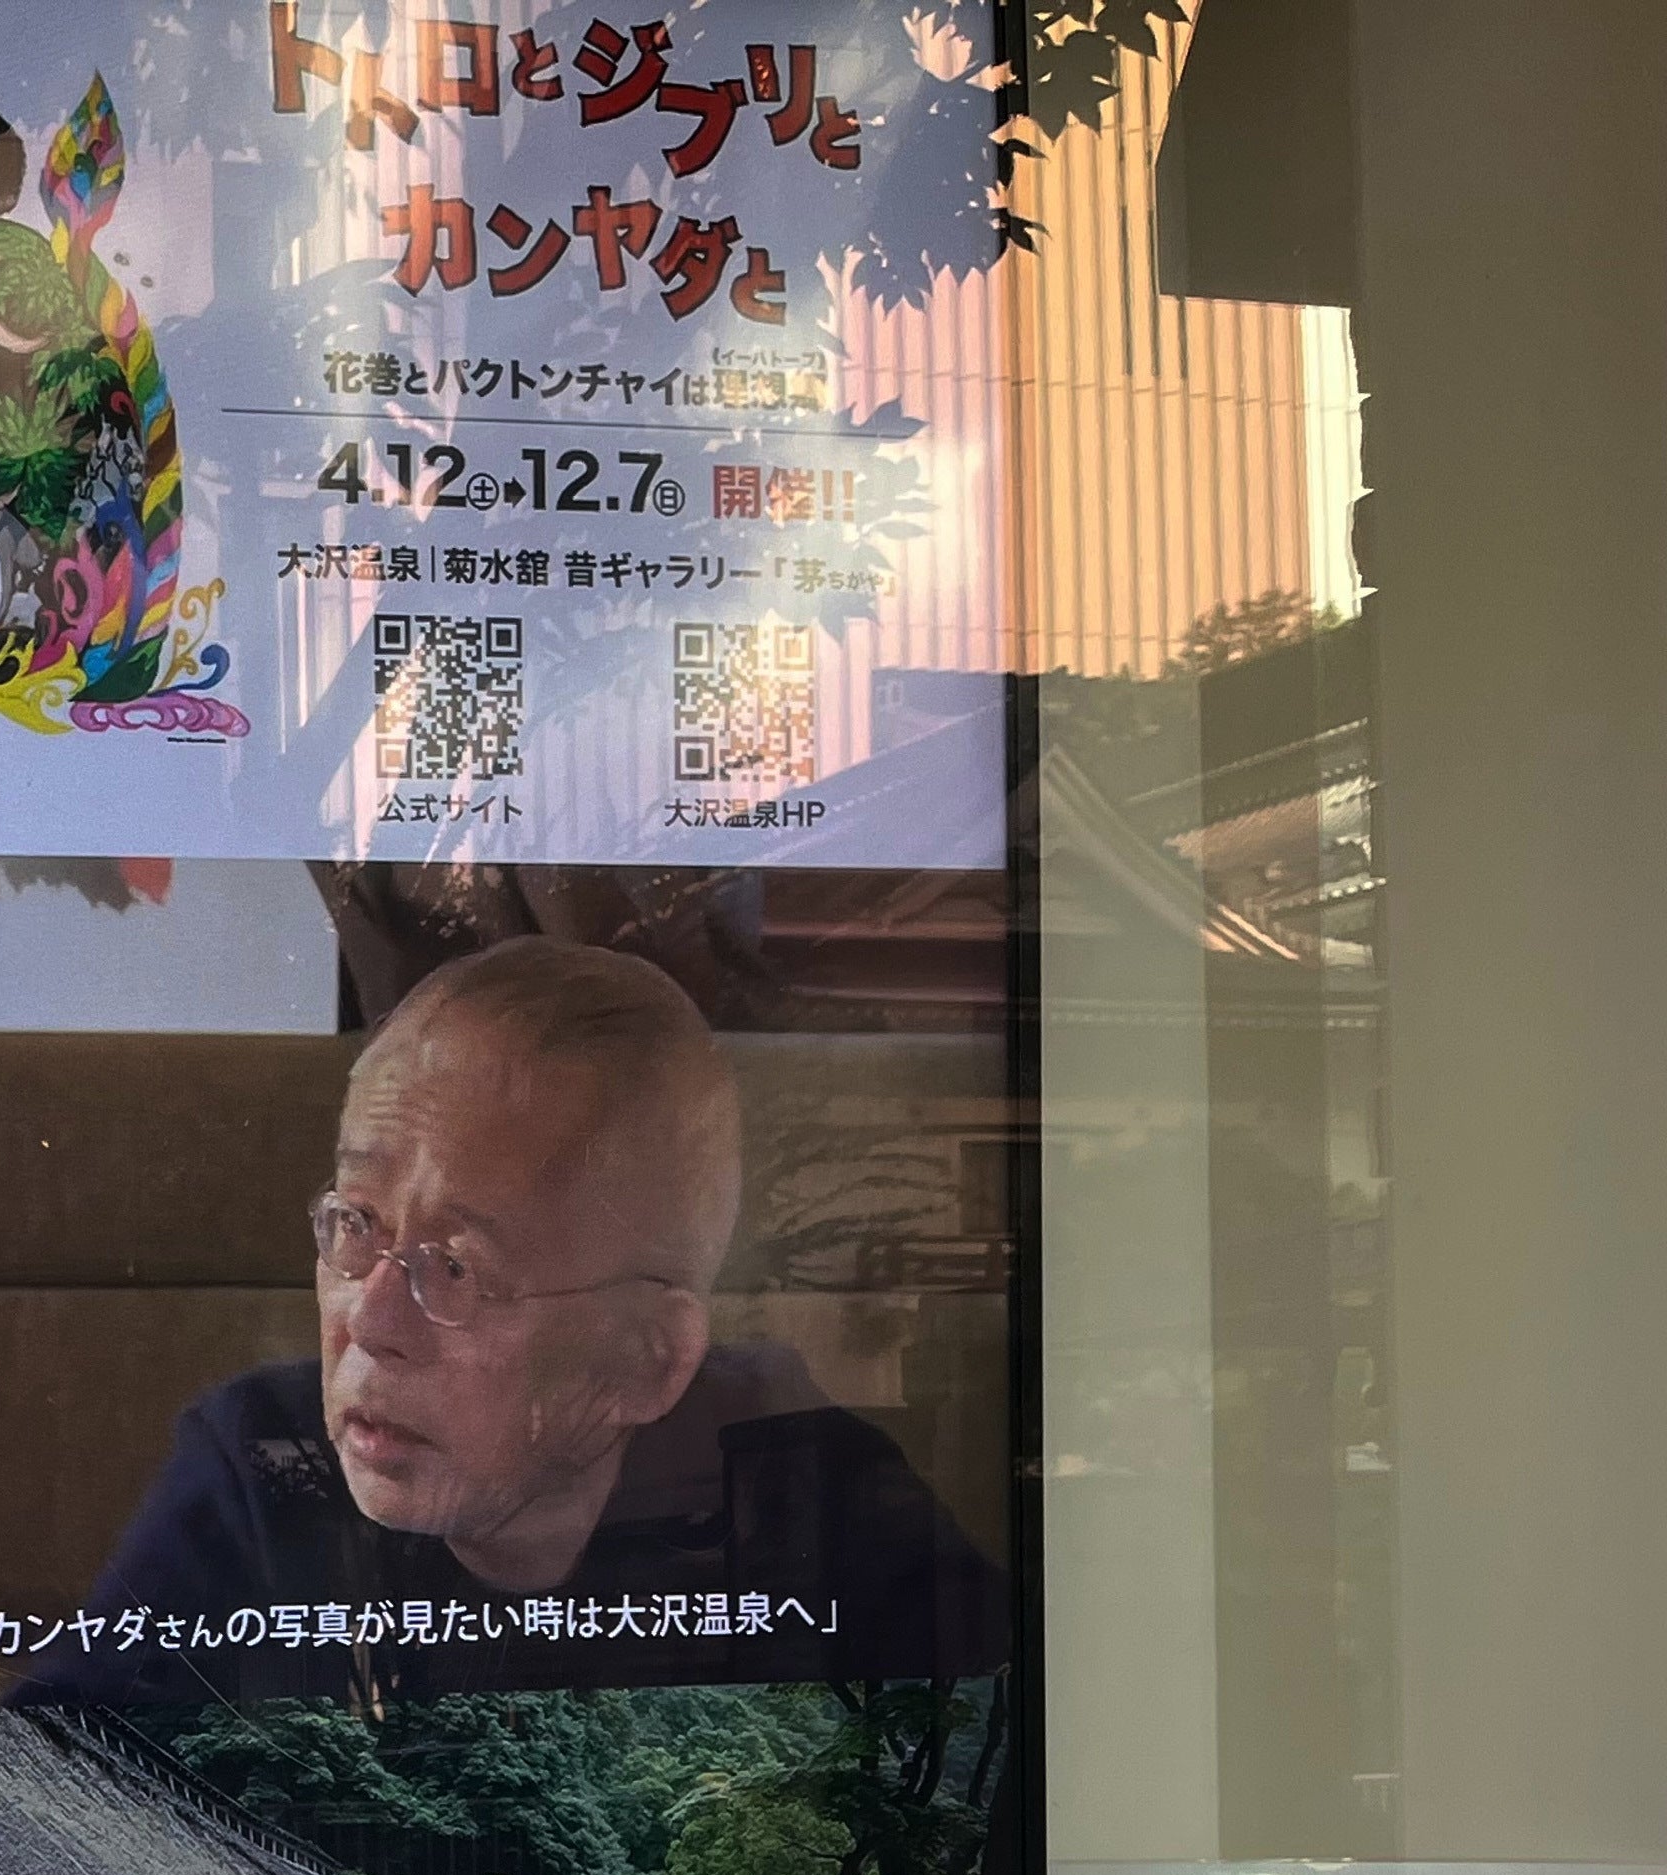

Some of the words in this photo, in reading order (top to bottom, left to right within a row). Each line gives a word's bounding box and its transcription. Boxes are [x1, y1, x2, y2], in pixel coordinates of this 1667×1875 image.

[269, 0, 861, 178] トトロとジブリと
[381, 185, 787, 325] カンヤダと
[377, 795, 524, 824] 公式サイト
[664, 798, 825, 829] 大沢温泉HP
